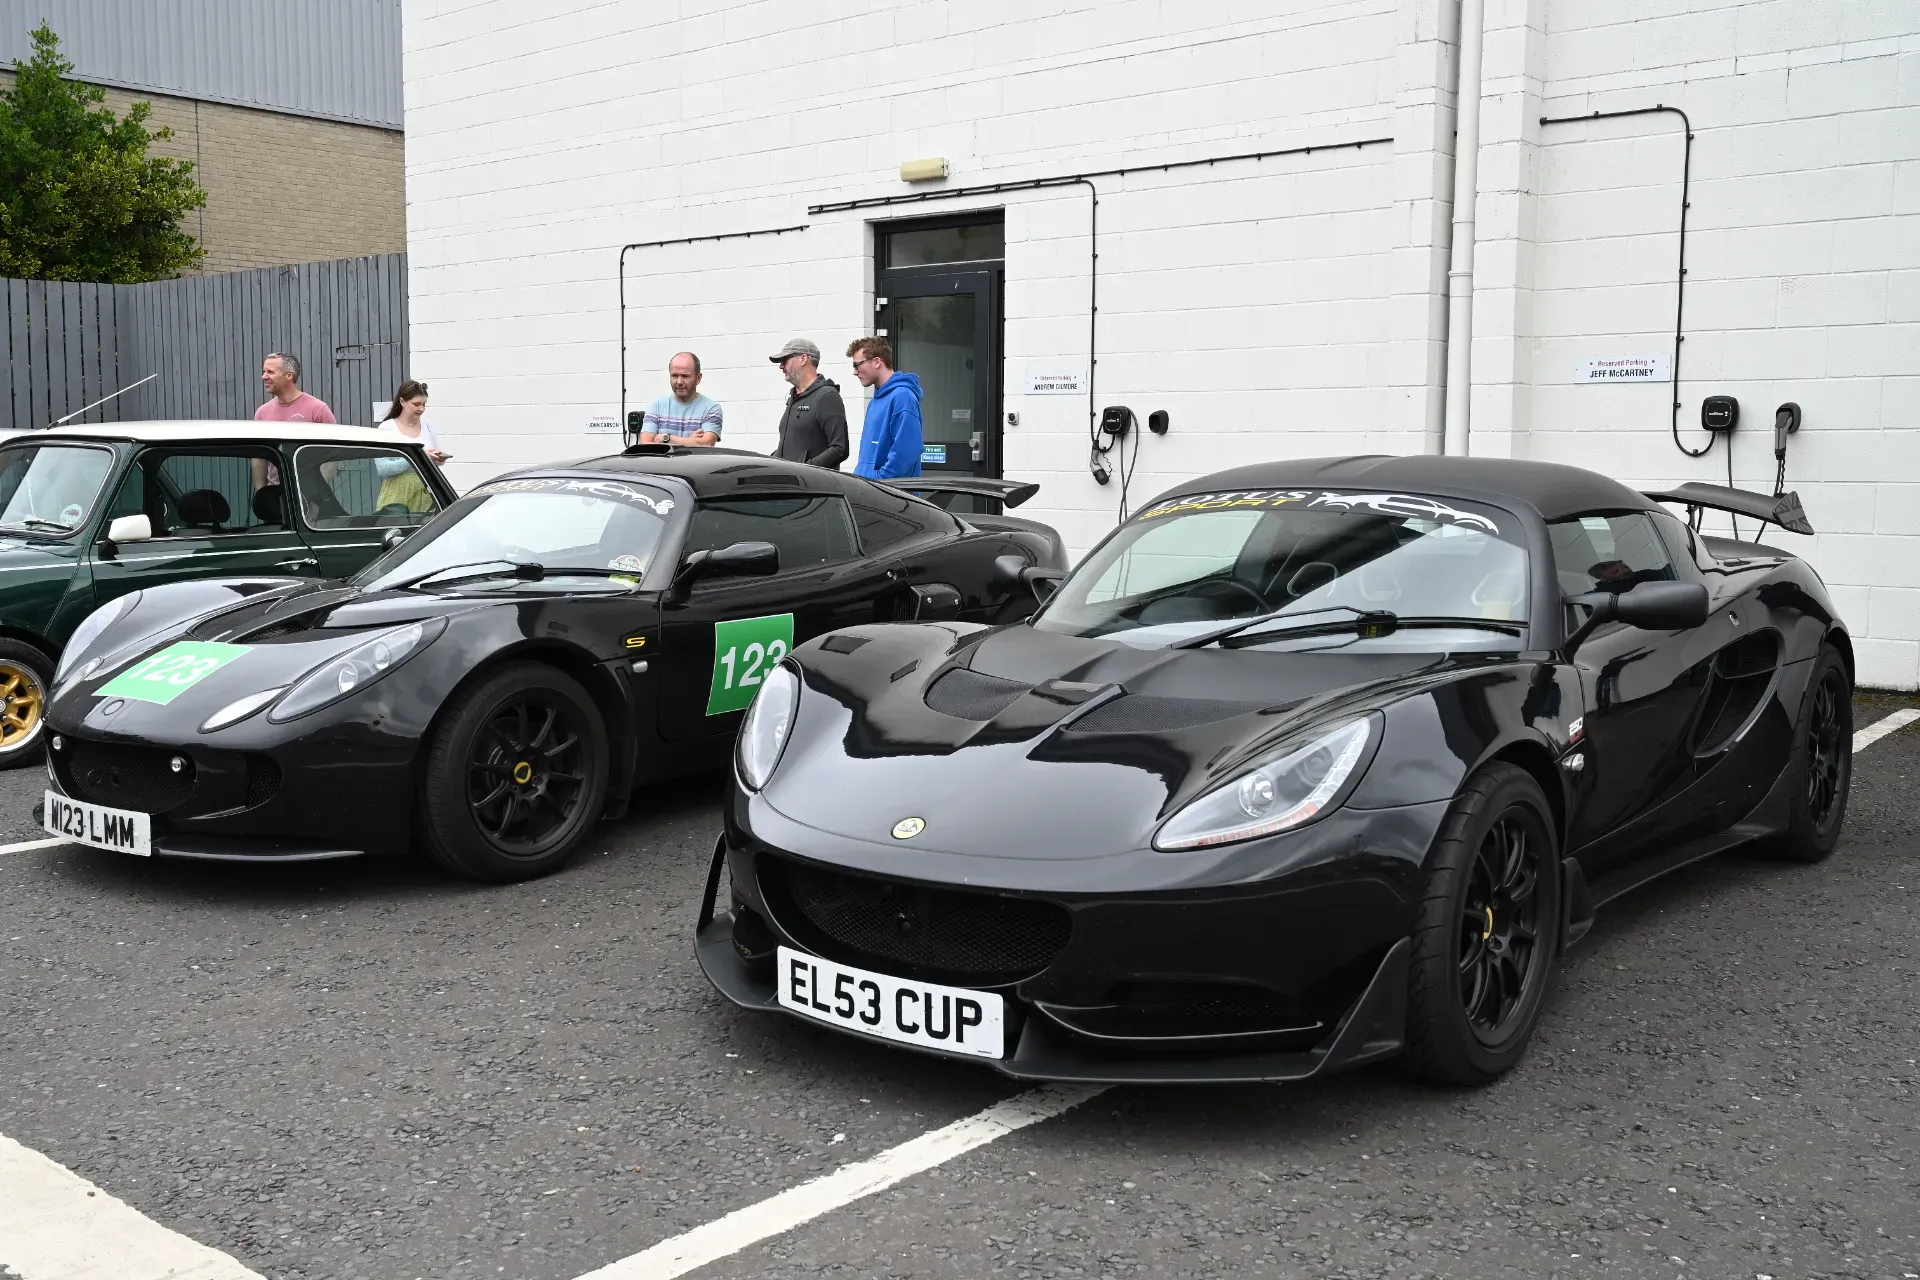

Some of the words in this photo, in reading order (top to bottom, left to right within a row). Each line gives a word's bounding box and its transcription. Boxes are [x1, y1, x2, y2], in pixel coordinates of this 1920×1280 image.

[1589, 370, 1607, 378] JEFF
[1609, 368, 1654, 378] McCARTNEY
[1625, 359, 1648, 367] Parking
[1138, 499, 1302, 521] SPORT
[1152, 491, 1312, 513] LOTUS
[129, 653, 219, 685] 123
[721, 639, 787, 690] 123
[52, 798, 84, 838] N123
[90, 810, 135, 849] LMM
[790, 958, 881, 1026] EL53
[895, 988, 983, 1044] CUP
